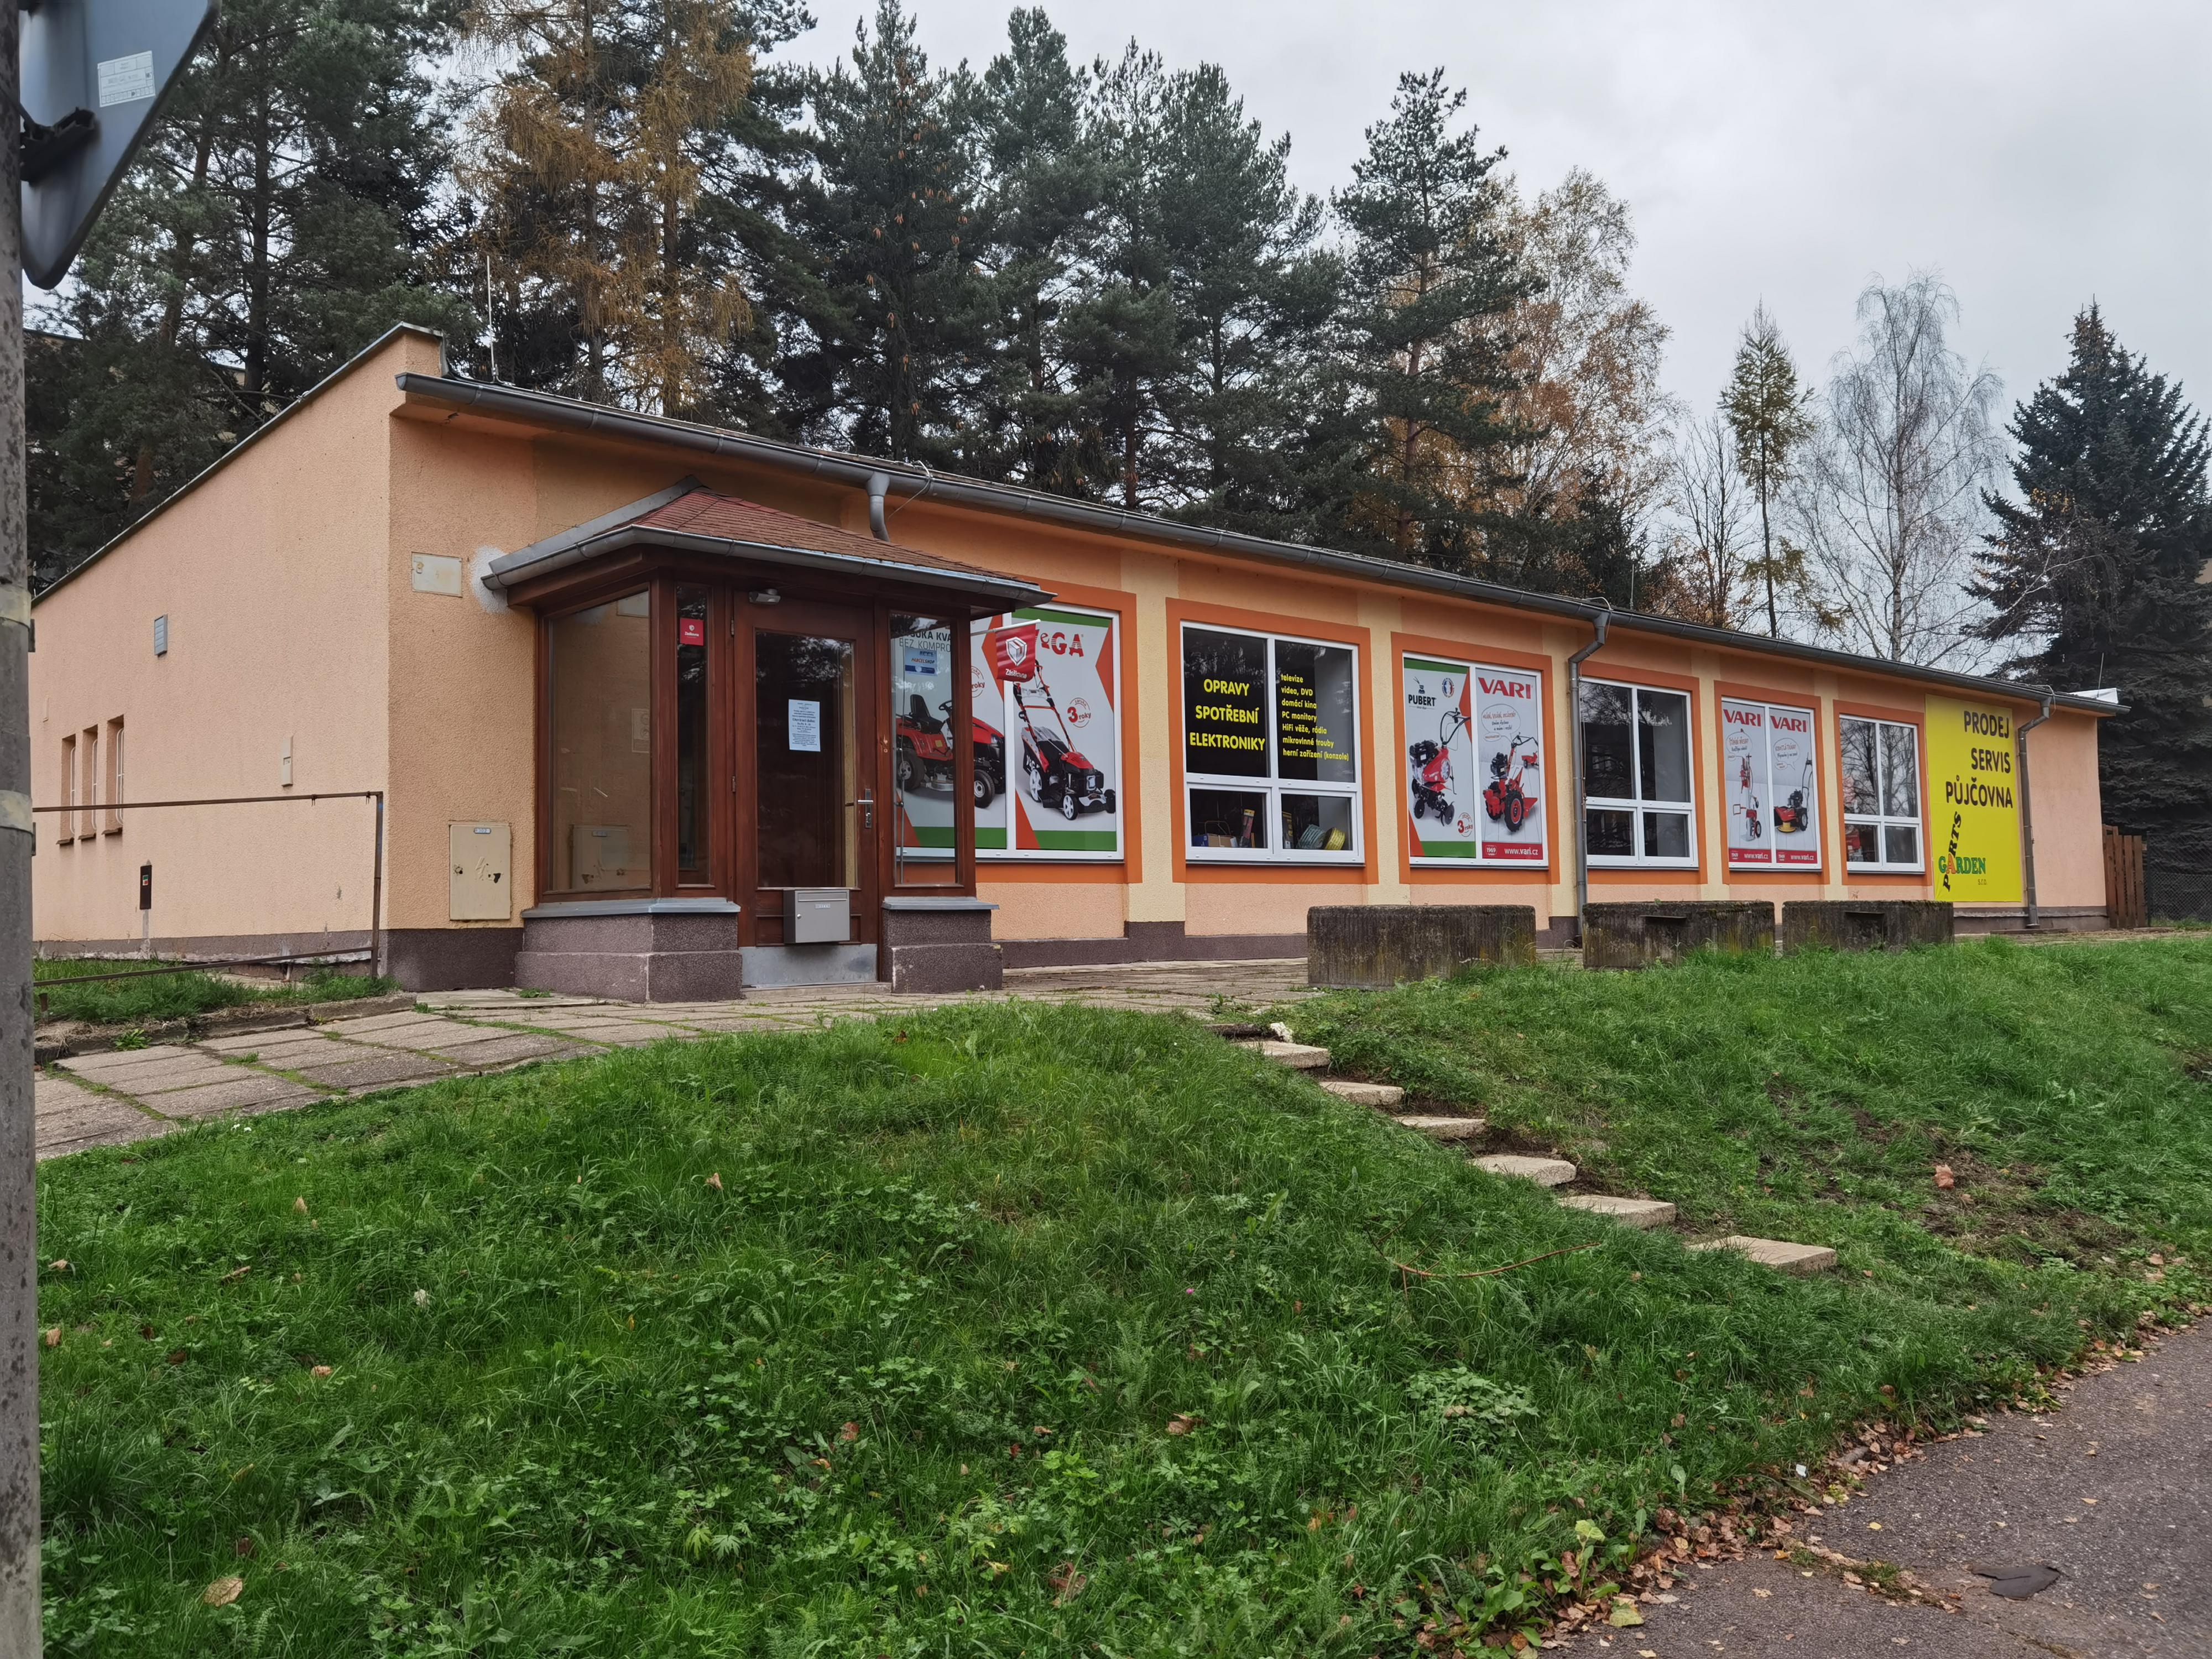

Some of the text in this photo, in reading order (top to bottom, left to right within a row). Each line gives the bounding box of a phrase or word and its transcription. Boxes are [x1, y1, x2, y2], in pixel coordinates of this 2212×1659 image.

[899, 638, 914, 648] BEZ
[1281, 674, 1303, 683] televize
[1203, 679, 1249, 696] OPRAVY
[1281, 686, 1313, 696] videa, DVD
[1478, 677, 1531, 699] VARI
[1282, 698, 1317, 709] domácí kina
[1408, 694, 1436, 707] PUBERT
[1067, 706, 1078, 723] 3
[1195, 703, 1260, 724] SPOTŘEBNÍ
[1291, 712, 1317, 723] monitory
[1723, 709, 1761, 727] VARI
[1295, 724, 1310, 734] věže,
[1770, 716, 1807, 733] VARI
[1964, 711, 2010, 739] PRODEJ
[1190, 732, 1265, 751] ELEKTRONIKY
[1283, 736, 1334, 749] mikrovlnné trouby
[1283, 748, 1349, 761] herní zařízení (konzole)
[1971, 748, 2011, 774] SERVIS
[1945, 775, 2013, 808] PŮJČOVNA
[1457, 820, 1464, 833] 3
[1938, 853, 1986, 874] GARDEN
